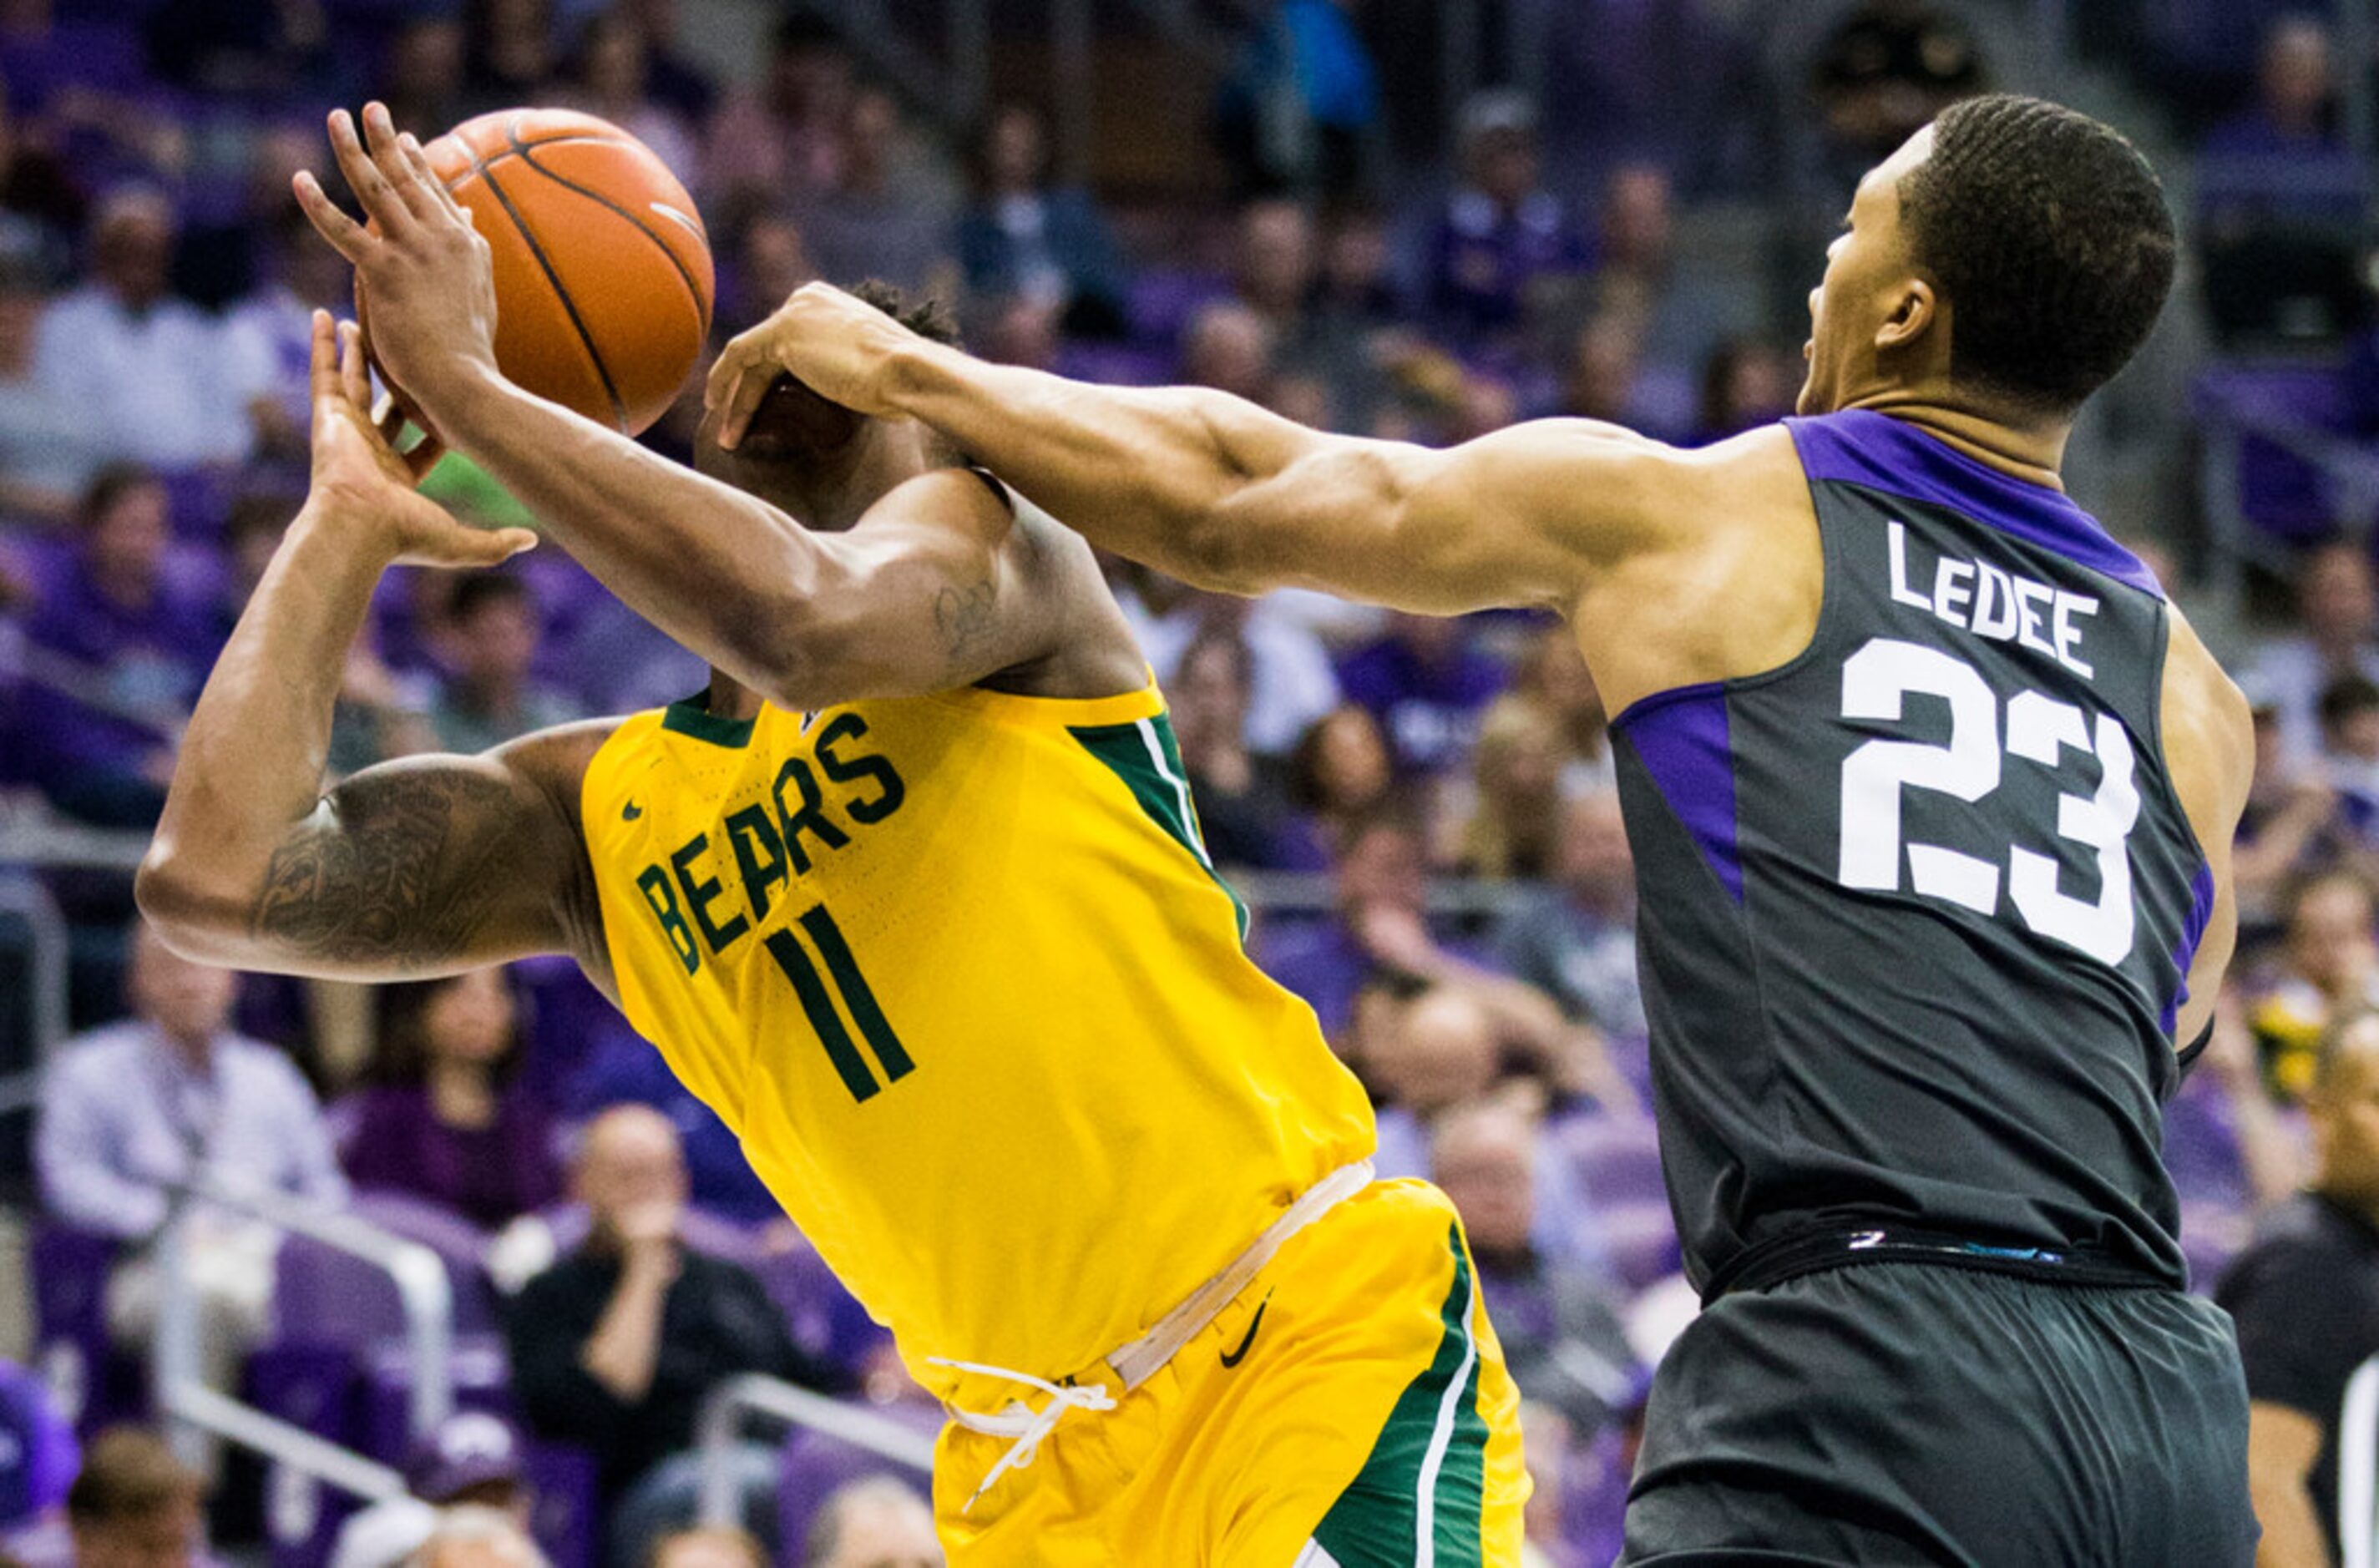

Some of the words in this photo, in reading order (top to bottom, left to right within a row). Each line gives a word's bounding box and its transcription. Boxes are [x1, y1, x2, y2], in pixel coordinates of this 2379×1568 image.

[637, 711, 907, 975] BEARS
[1839, 638, 2141, 967] 23
[763, 903, 915, 1103] 11
